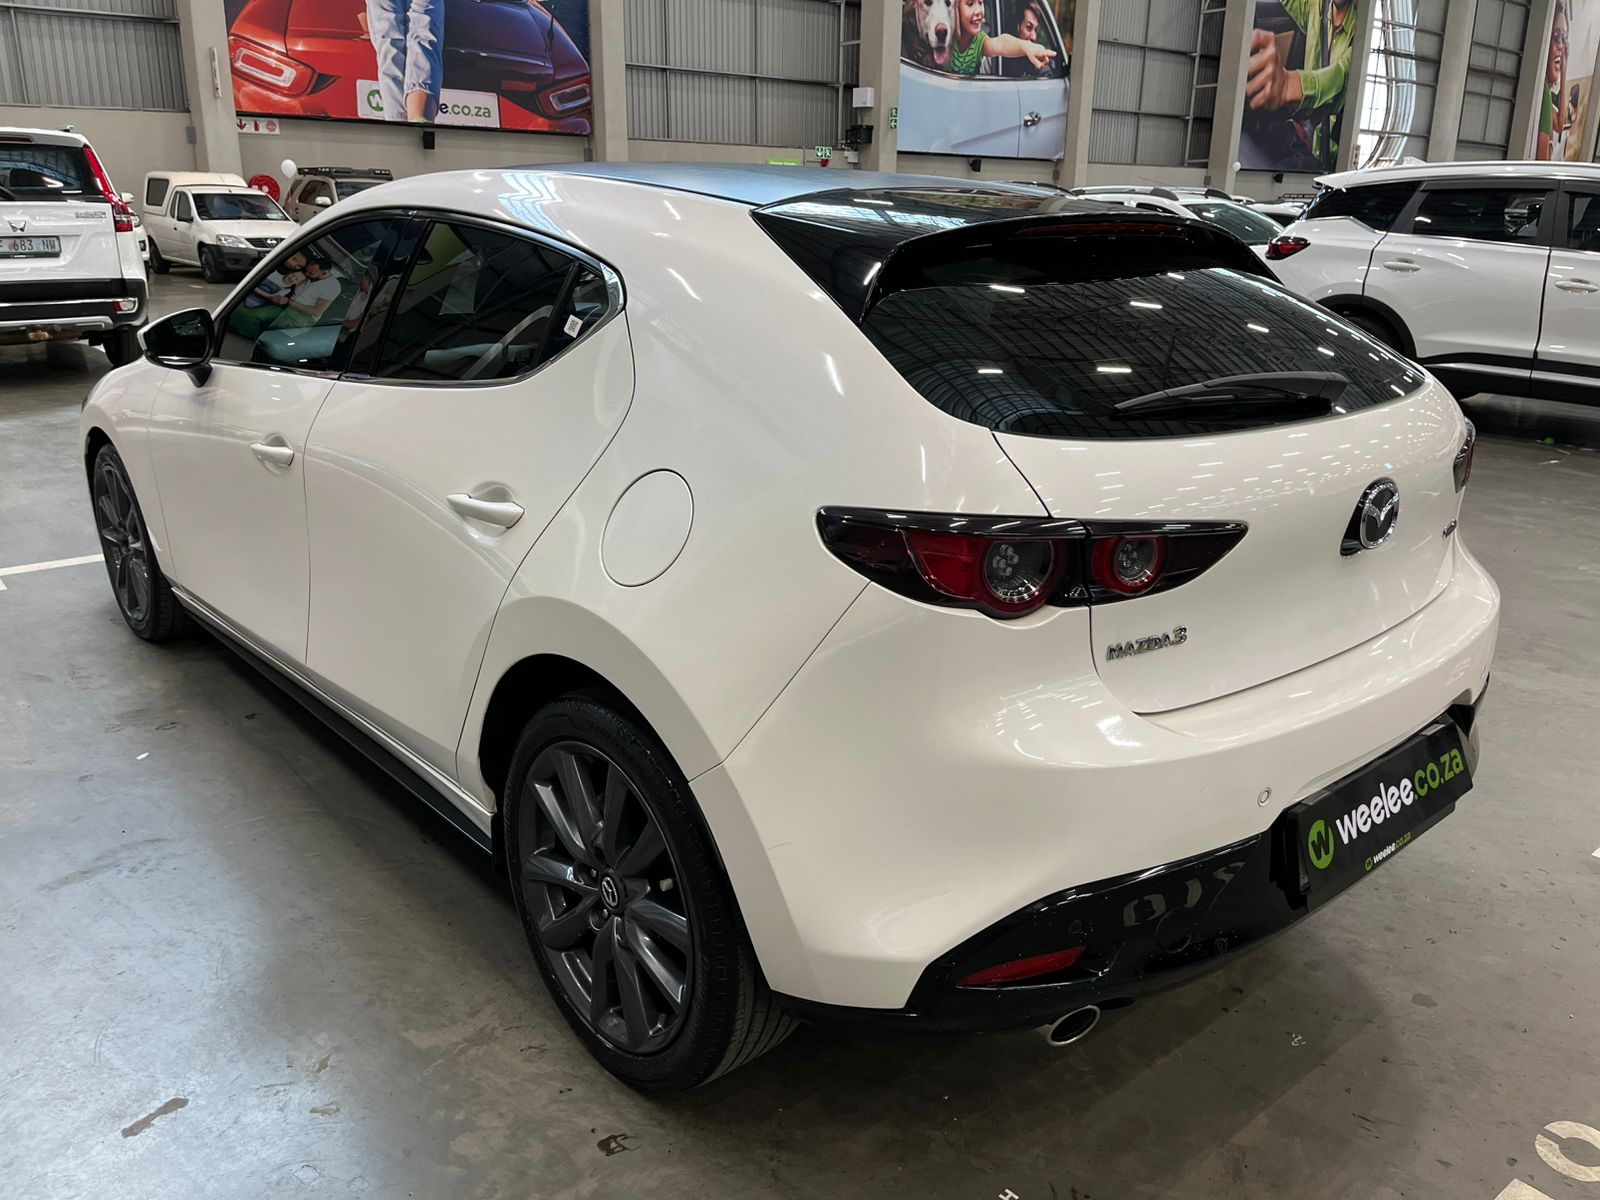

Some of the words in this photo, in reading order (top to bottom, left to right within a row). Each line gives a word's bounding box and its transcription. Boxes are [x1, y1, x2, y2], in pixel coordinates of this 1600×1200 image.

[439, 103, 492, 118] e.co.za
[13, 239, 33, 251] 683
[42, 239, 56, 250] NW
[1106, 625, 1188, 661] MAZDA3
[1335, 748, 1464, 845] weelee.co.za
